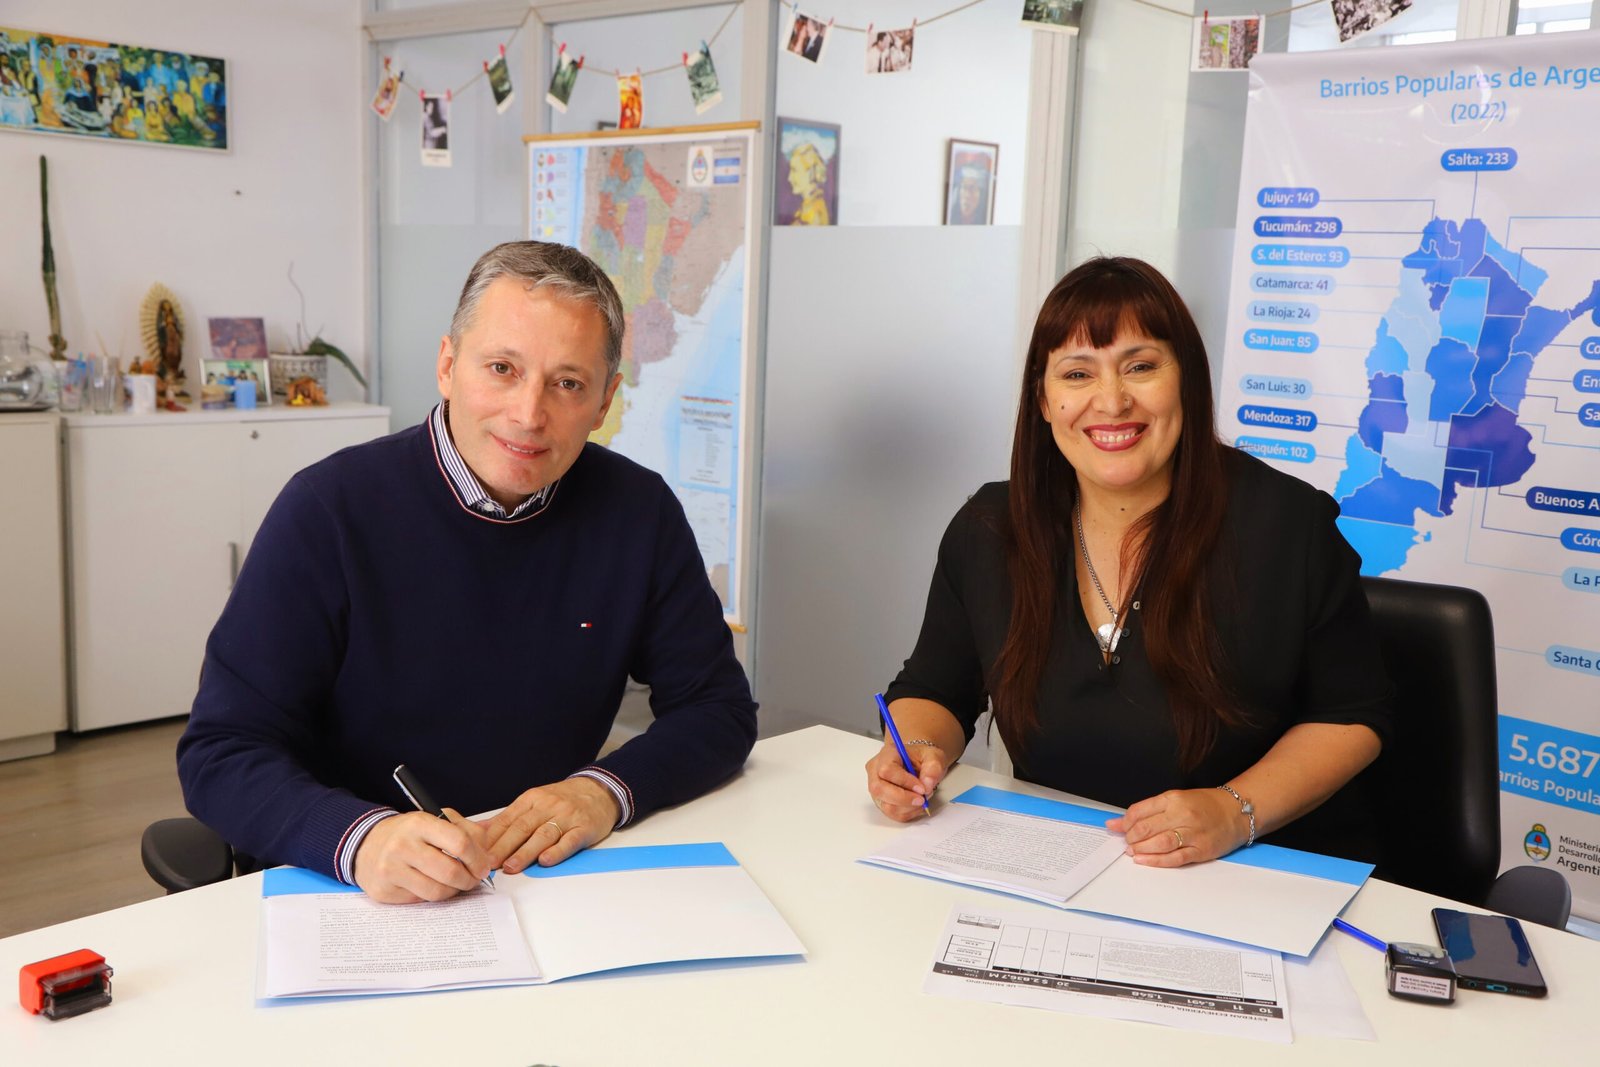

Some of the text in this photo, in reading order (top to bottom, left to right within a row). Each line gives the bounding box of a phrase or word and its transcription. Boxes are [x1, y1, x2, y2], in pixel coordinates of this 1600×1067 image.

[1320, 65, 1600, 98] Barrios Populares de Arge
[1451, 101, 1507, 124] (2022)
[1447, 152, 1509, 166] Salta: 233
[1263, 192, 1315, 206] Jujuy: 141
[1260, 220, 1337, 234] Tucumán: 298
[1257, 249, 1344, 263] S. del Estero: 93
[1256, 276, 1329, 290] Catamarca: 41
[1253, 305, 1311, 320] La Rioja: 24
[1249, 333, 1311, 348] San Juan: 85
[1246, 379, 1306, 395] San Luis: 30
[1244, 409, 1312, 427] Mendoza: 317
[1240, 440, 1309, 459] Neuquén: 102
[1535, 491, 1586, 510] Buenos
[1573, 572, 1591, 586] La
[1553, 651, 1592, 669] Santa
[1508, 733, 1600, 778] 5.687
[1498, 769, 1540, 792] arrios
[1560, 835, 1600, 854] Ministeri
[1131, 991, 1163, 1000] 1.548
[1229, 1012, 1268, 1022] ESTEBAN
